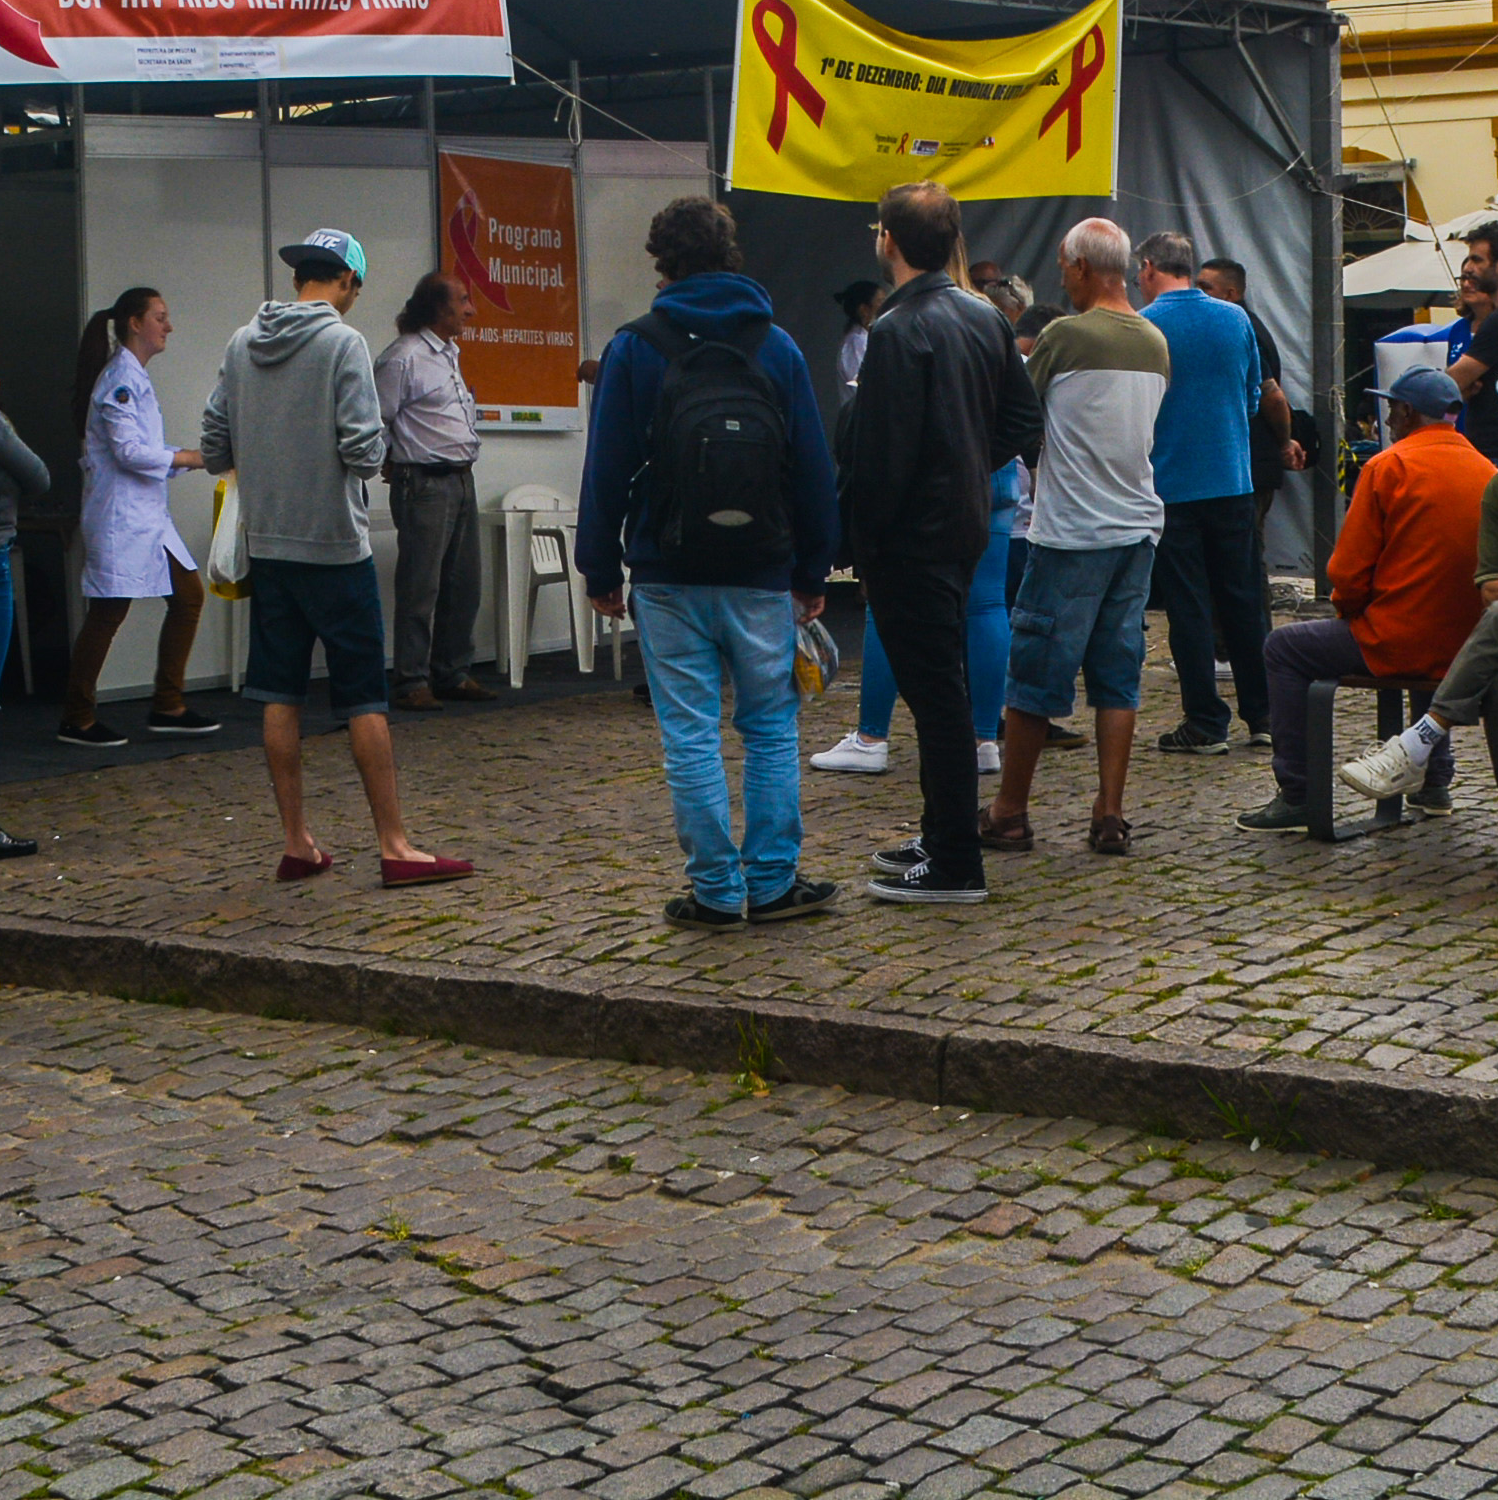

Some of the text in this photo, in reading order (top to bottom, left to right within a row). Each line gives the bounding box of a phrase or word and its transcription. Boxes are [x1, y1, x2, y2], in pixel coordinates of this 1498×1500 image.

[835, 59, 854, 80] DE
[855, 63, 923, 91] DEZEMBRO:
[925, 75, 947, 95] DIA
[948, 79, 995, 100] MUNDIAL
[488, 217, 562, 251] Programa
[488, 257, 565, 292] Municipal
[545, 331, 574, 347] VIRAIS
